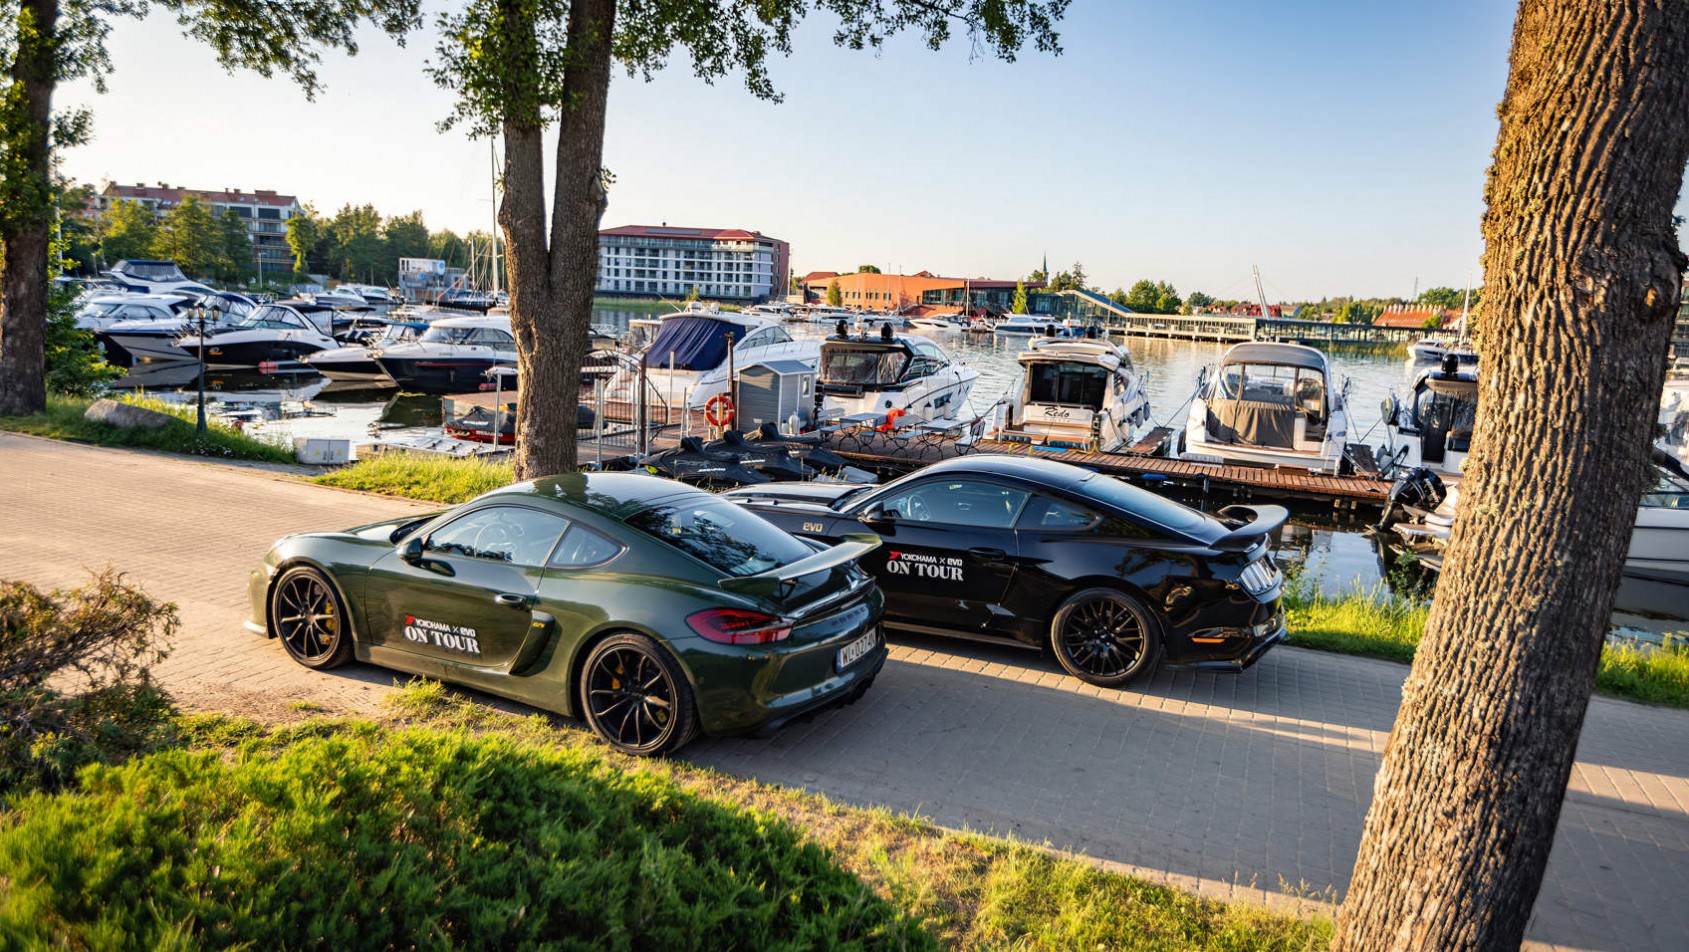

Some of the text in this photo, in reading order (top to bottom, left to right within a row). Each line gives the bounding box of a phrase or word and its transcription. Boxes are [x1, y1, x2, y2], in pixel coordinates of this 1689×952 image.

[900, 552, 937, 564] YOKOHAMA
[887, 560, 964, 581] ON TOUR
[415, 618, 450, 633] YOKOHAMA
[404, 625, 480, 654] ON TOUR
